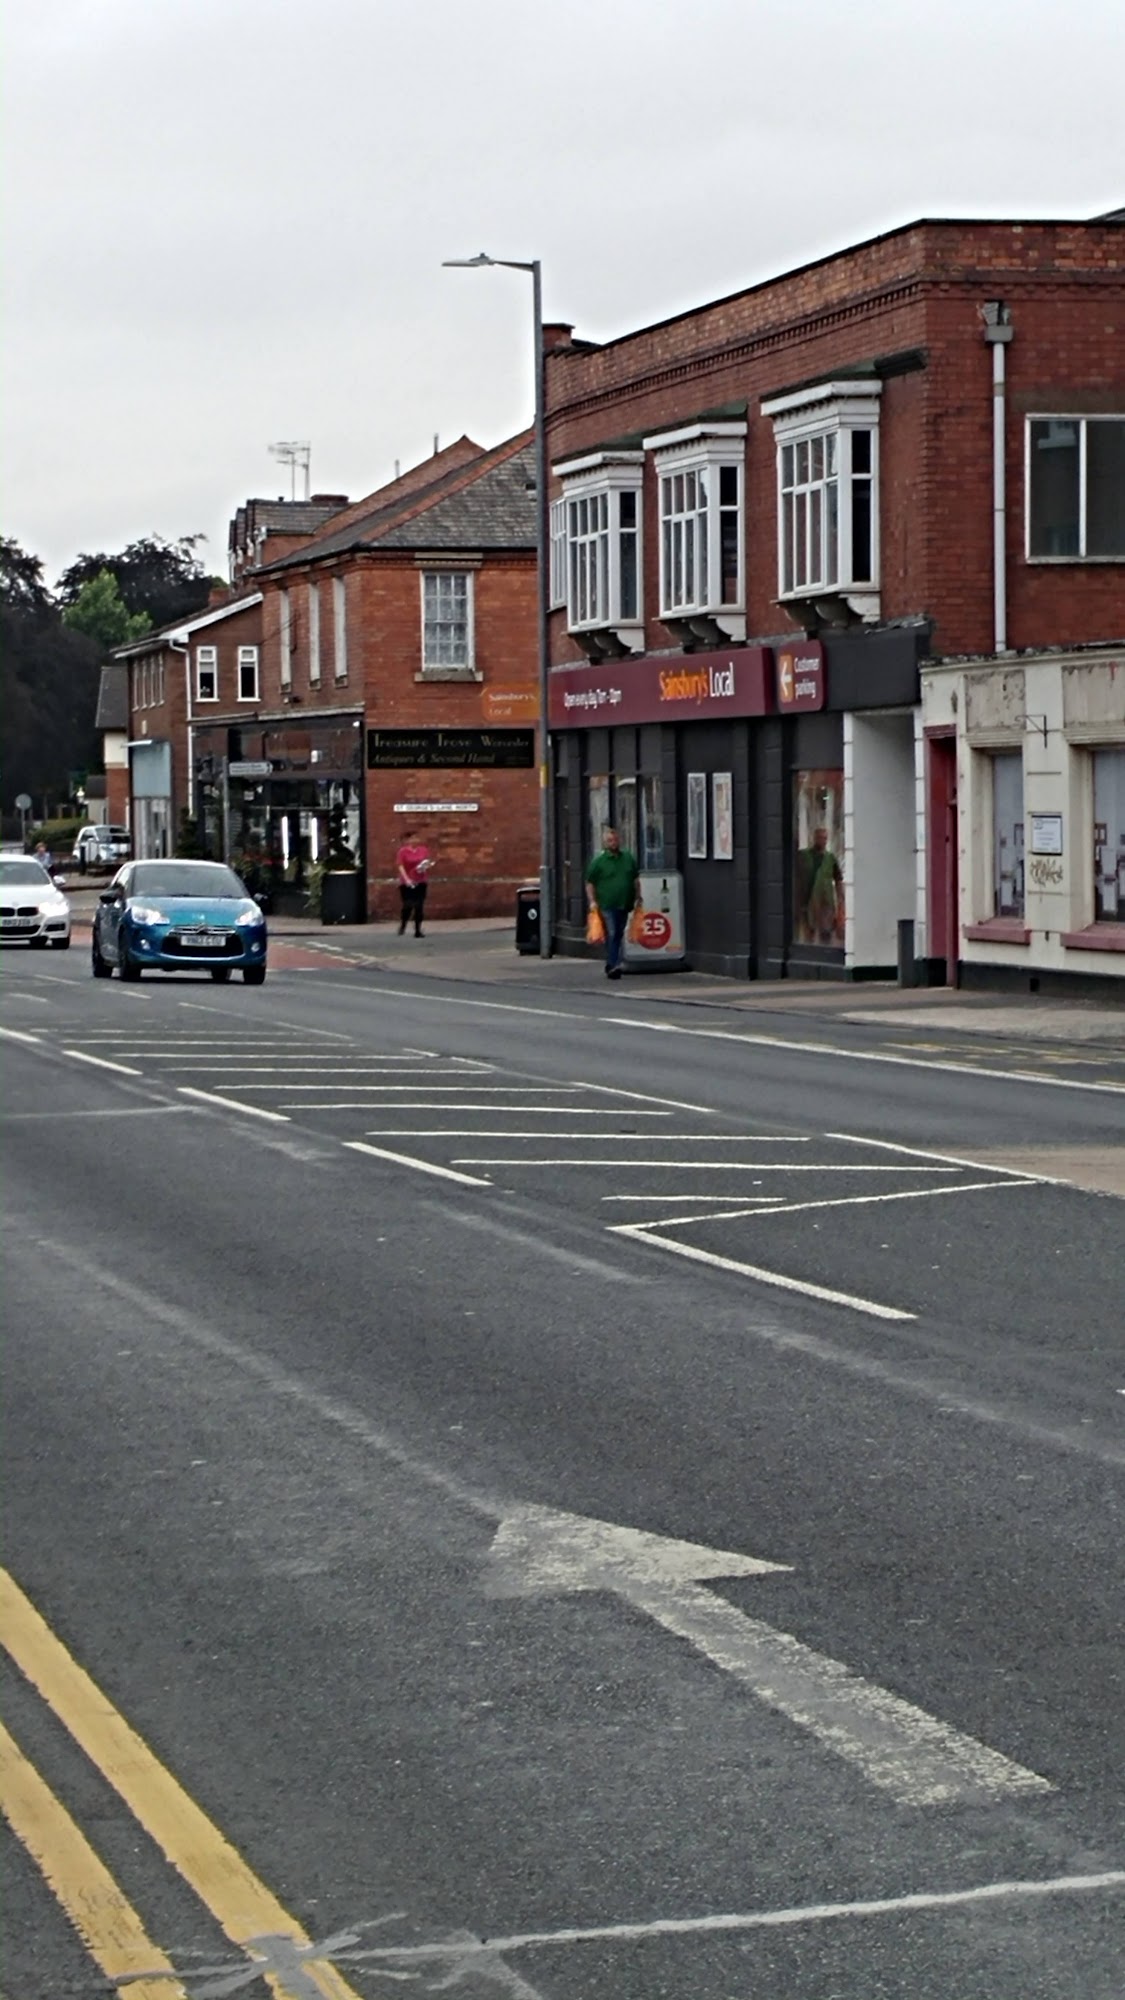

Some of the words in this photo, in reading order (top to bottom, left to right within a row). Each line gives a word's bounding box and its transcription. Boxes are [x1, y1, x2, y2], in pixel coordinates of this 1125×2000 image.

[794, 657, 820, 673] Customer
[659, 667, 708, 705] Sainsbury's
[709, 662, 735, 697] Local
[795, 679, 816, 699] parking
[372, 733, 428, 747] Treasure
[434, 733, 473, 747] Trove
[372, 754, 414, 766] Antiques
[417, 754, 427, 764] &
[429, 754, 465, 764] Second
[466, 754, 496, 764] Hand
[644, 919, 666, 936] £5
